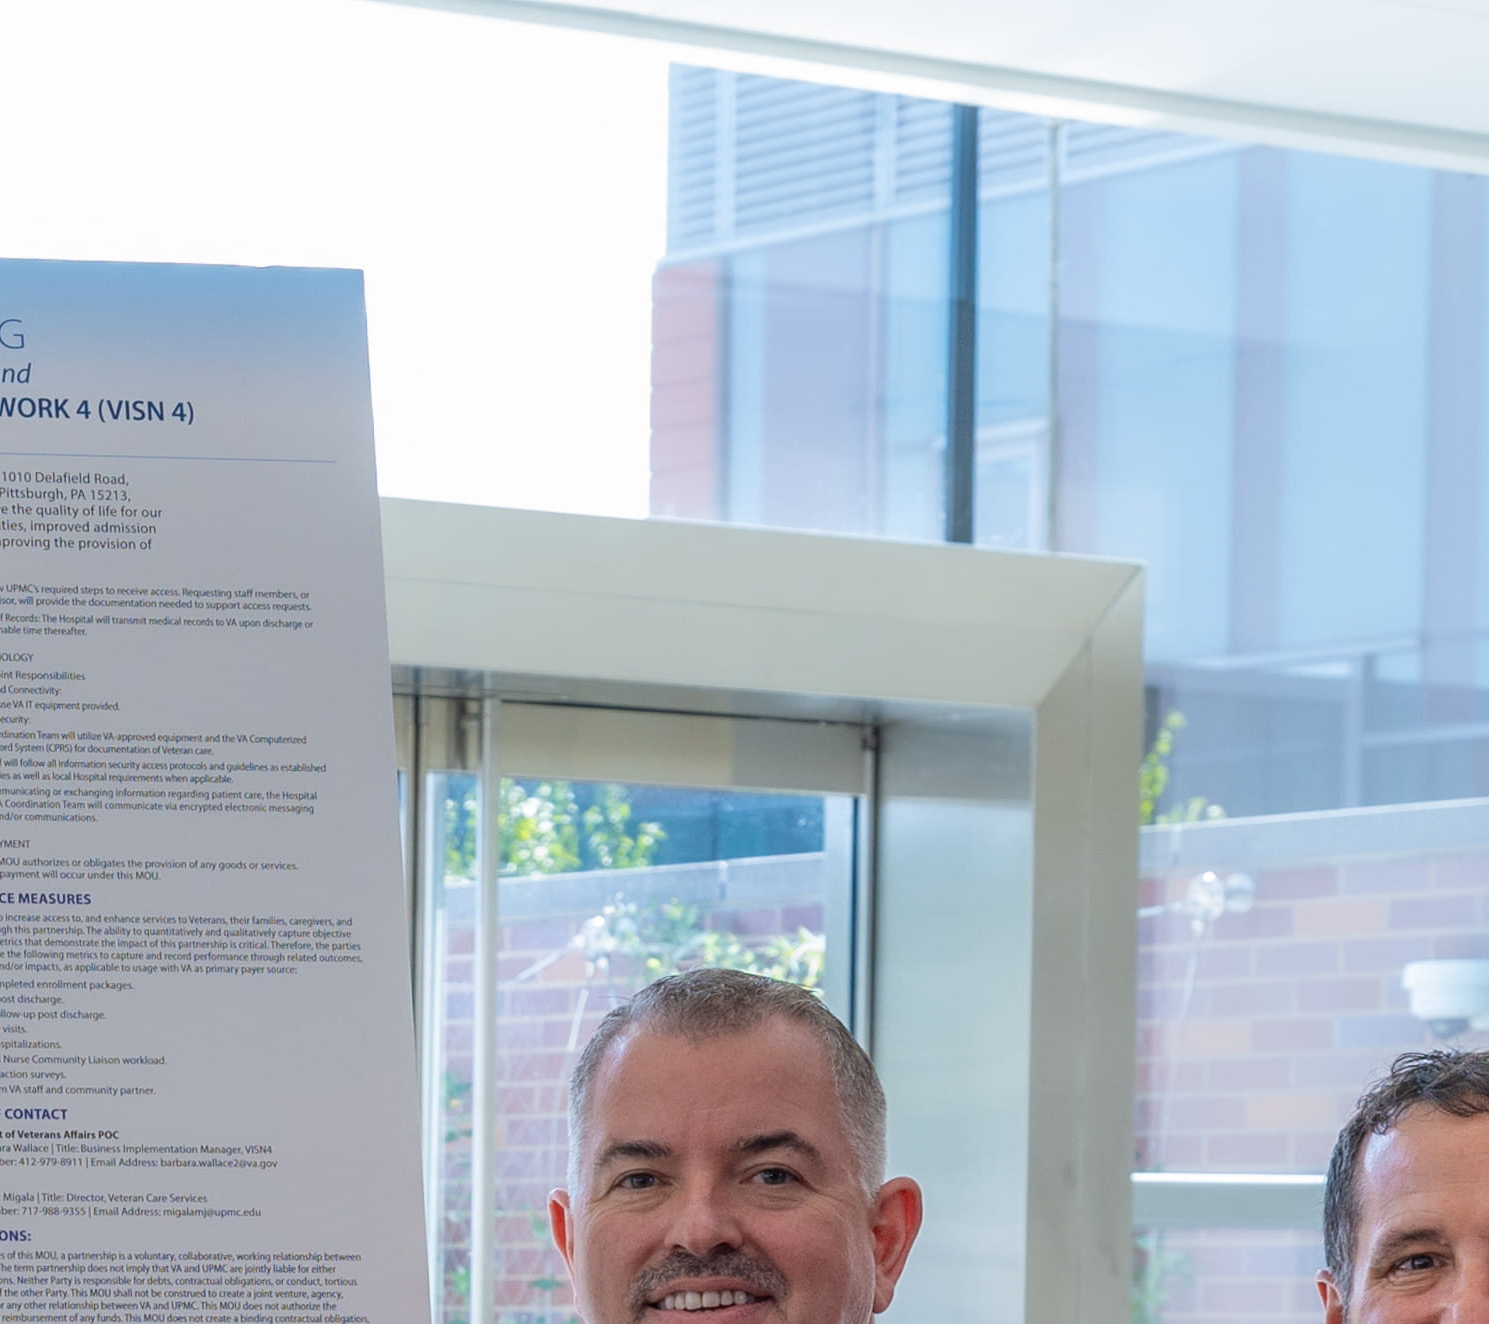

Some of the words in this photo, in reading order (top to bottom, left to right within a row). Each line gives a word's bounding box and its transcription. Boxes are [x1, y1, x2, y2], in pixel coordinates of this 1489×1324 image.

[75, 399, 91, 419] 4
[98, 398, 164, 423] (VISN
[171, 401, 194, 425] 4)
[2, 471, 31, 483] 1010
[34, 471, 90, 484] Delafield
[93, 472, 129, 486] Road,
[18, 892, 91, 905] MEASURES
[4, 1108, 68, 1120] CONTACT
